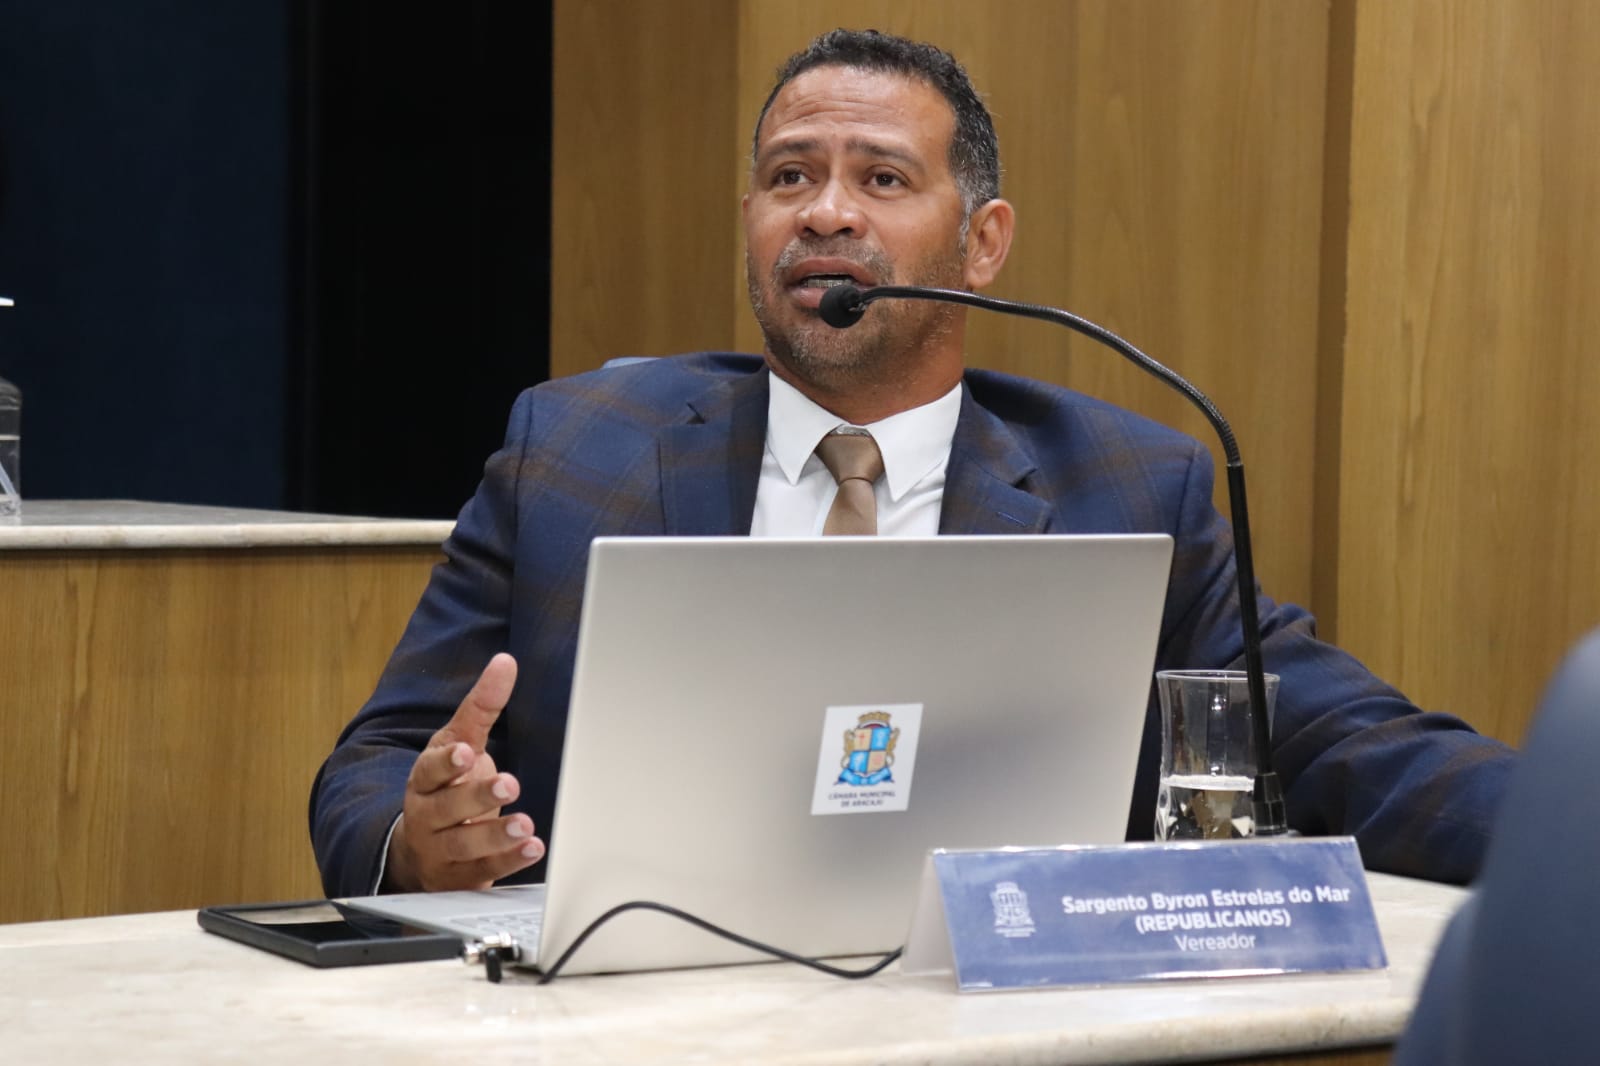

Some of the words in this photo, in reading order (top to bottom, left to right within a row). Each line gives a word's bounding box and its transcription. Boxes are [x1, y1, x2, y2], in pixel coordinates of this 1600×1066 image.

[860, 790, 896, 798] MUNICIPAL
[1062, 895, 1148, 914] Sargento
[1151, 892, 1209, 911] Byron
[1211, 889, 1285, 907] Estrelas
[1288, 886, 1313, 903] do
[1315, 885, 1351, 902] Mar
[1135, 908, 1292, 935] (REPUBLICANOS)
[1174, 932, 1256, 952] Vereador
